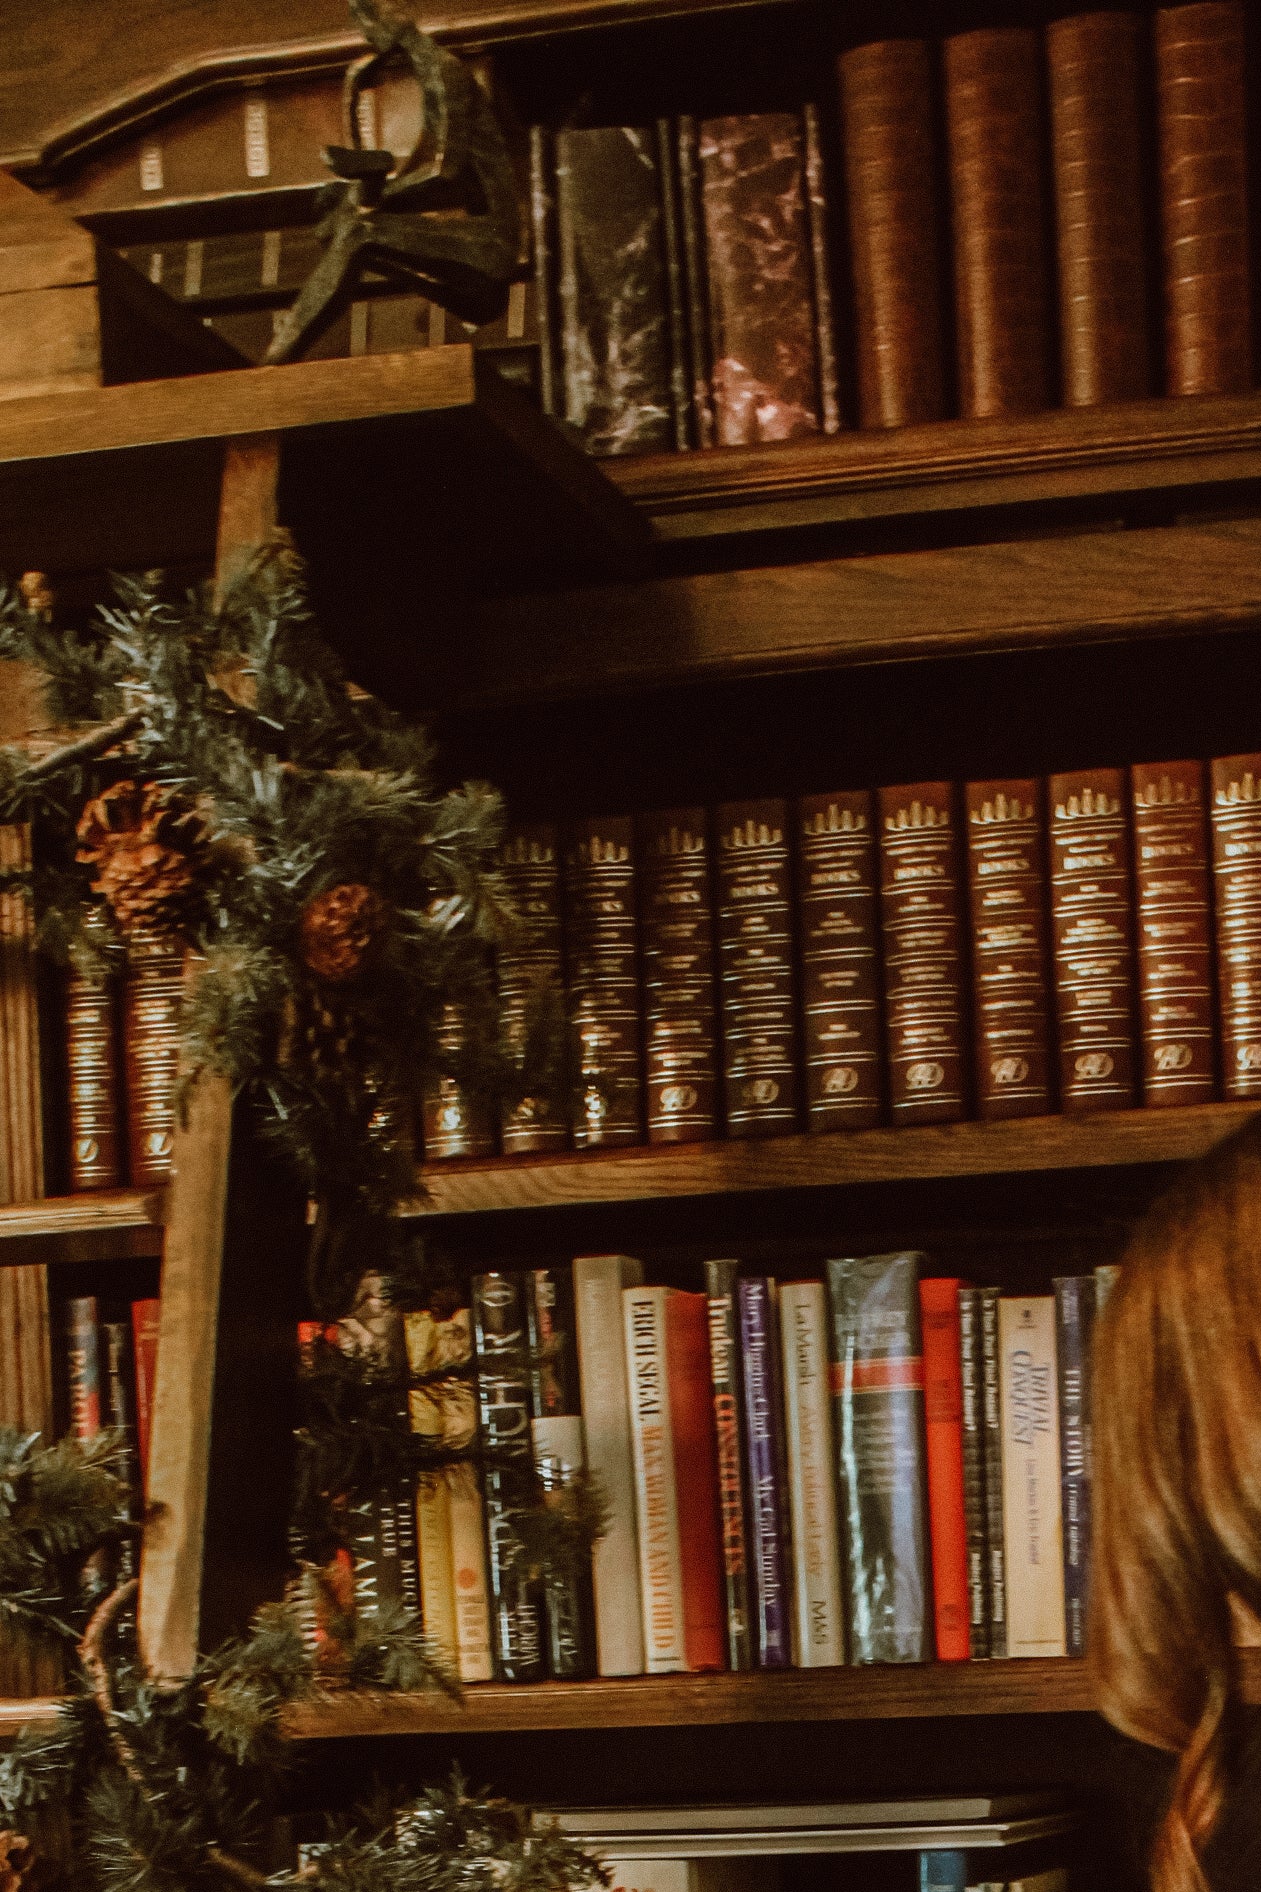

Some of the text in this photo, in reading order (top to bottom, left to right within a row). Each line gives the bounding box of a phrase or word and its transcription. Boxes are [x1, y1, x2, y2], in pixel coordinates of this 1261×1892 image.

[708, 1294, 734, 1383] Trudeau
[1010, 1351, 1031, 1446] CONQUEST
[1032, 1365, 1050, 1433] TRIVIAL
[1065, 1368, 1084, 1406] THE
[631, 1300, 676, 1648] ERICH SEGAL MAN WOMAN AND CHILD
[519, 1605, 541, 1666] WRIGHT
[811, 1600, 829, 1645] M&S
